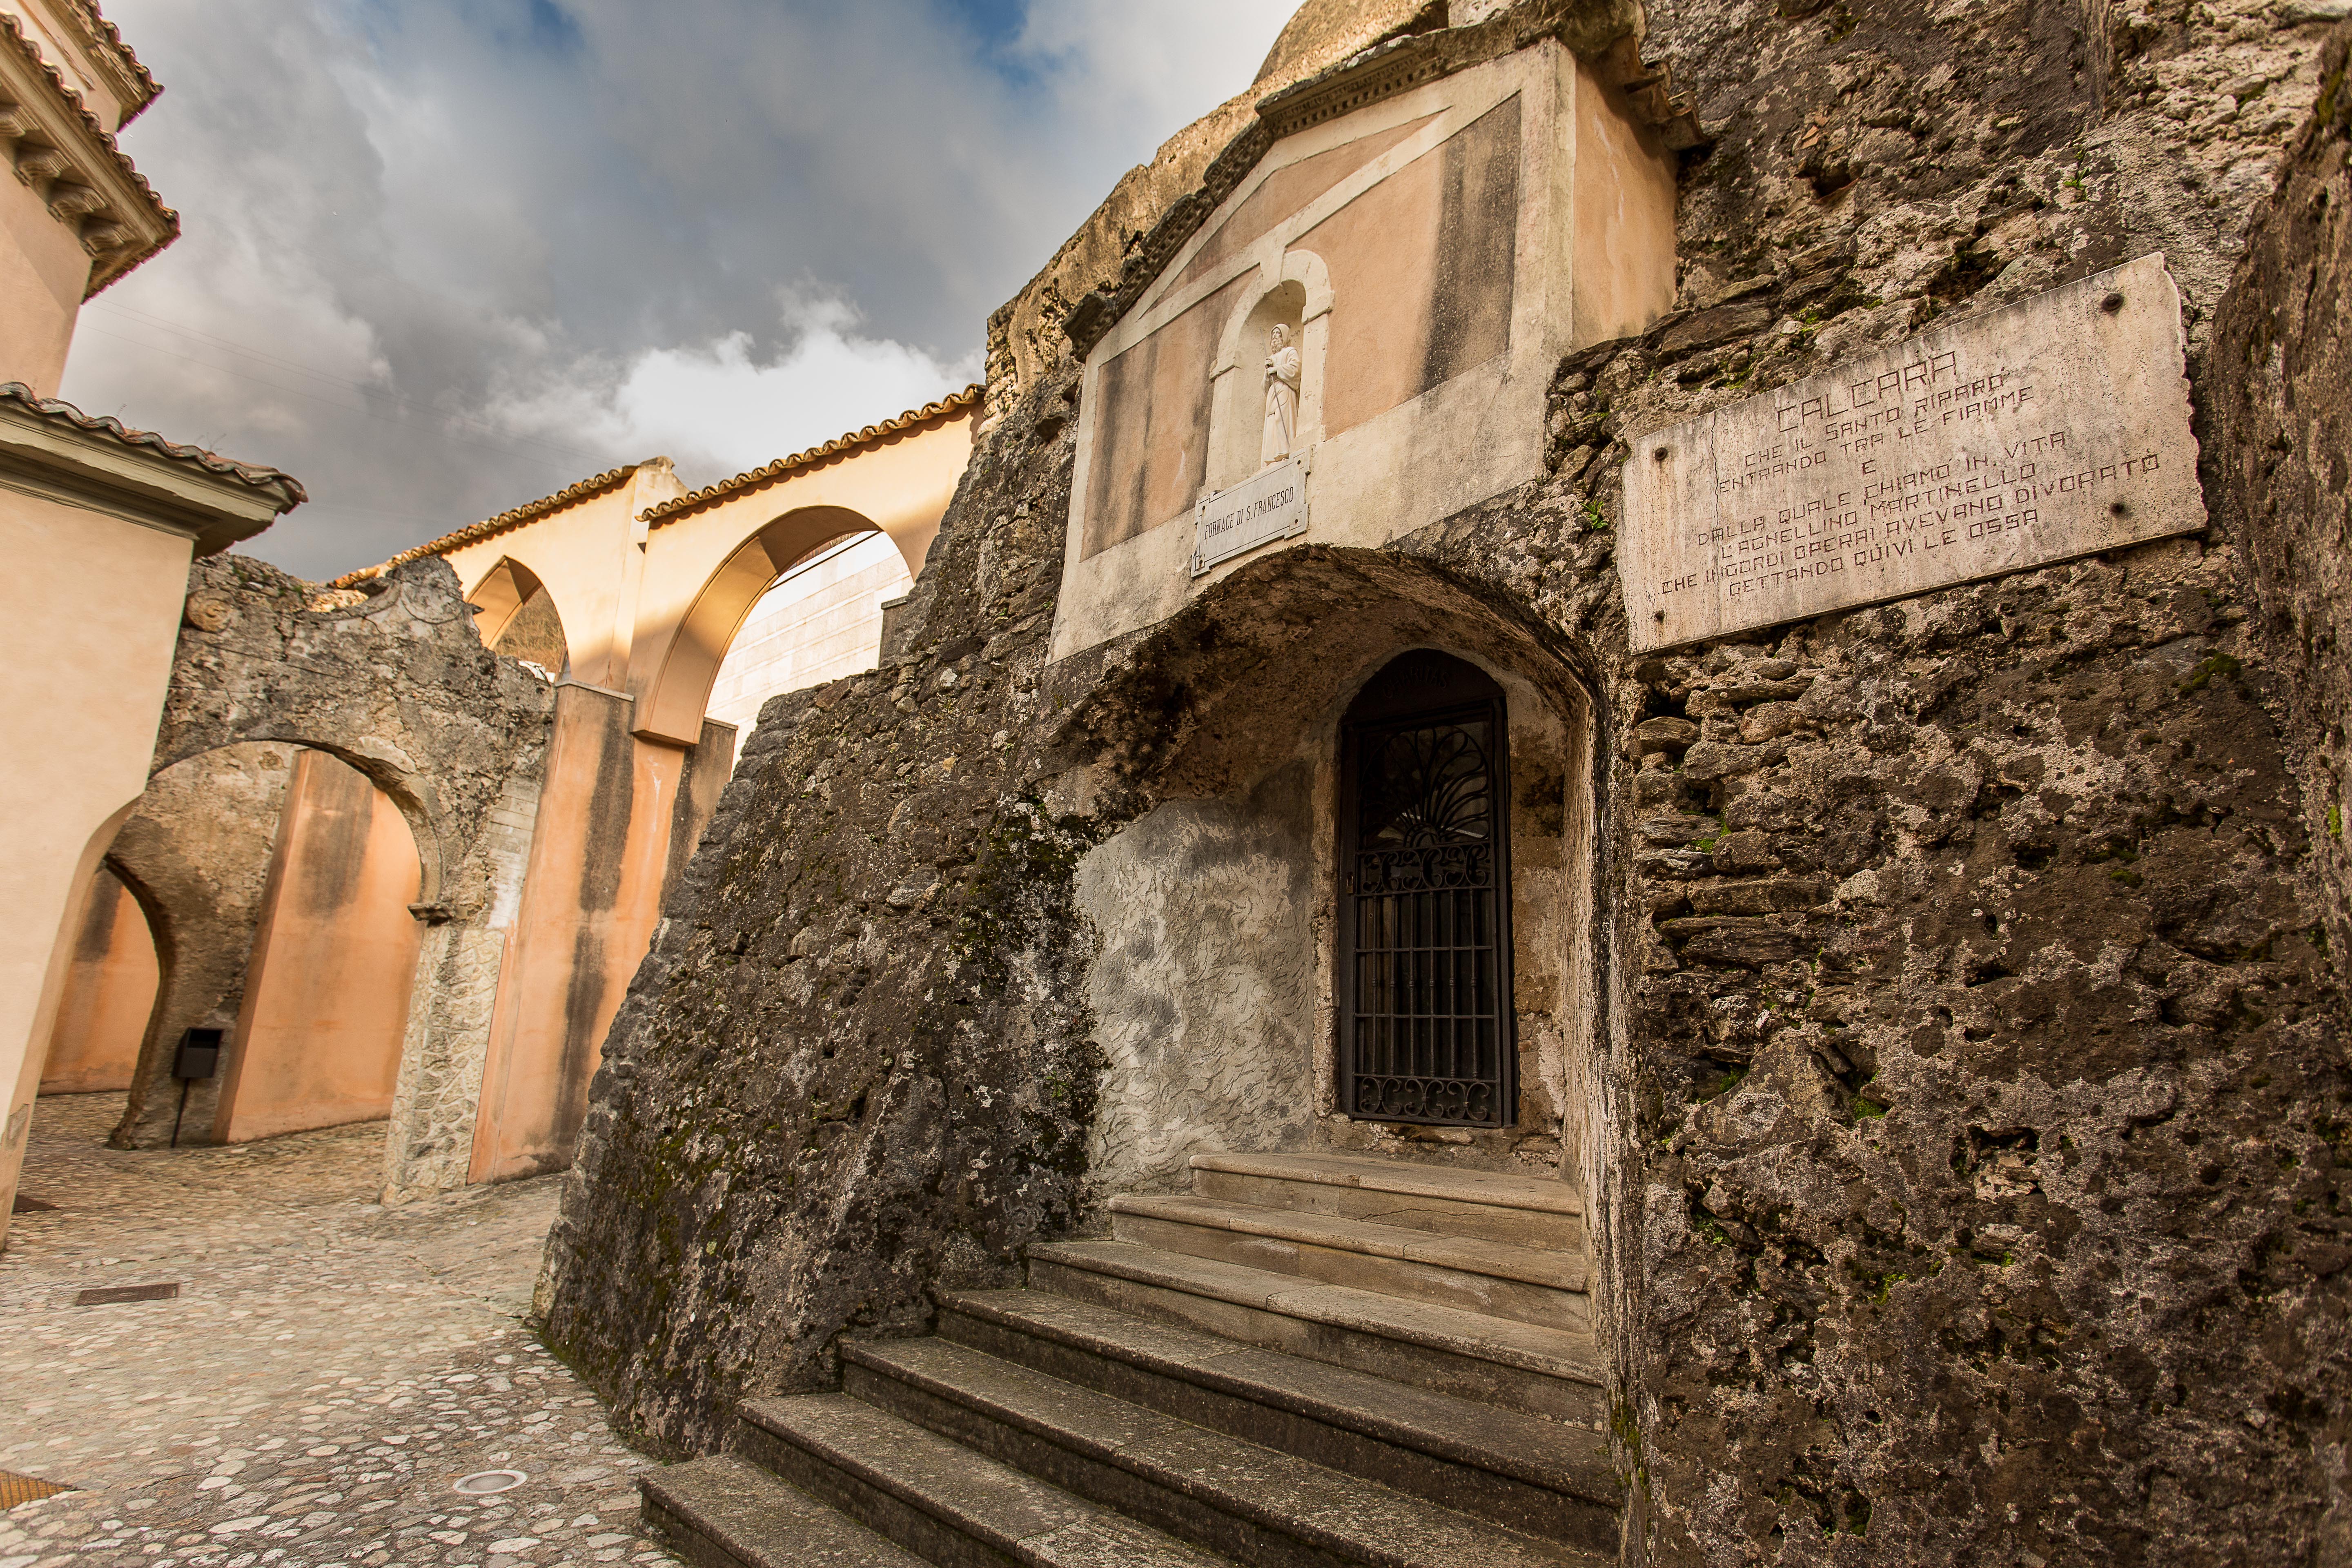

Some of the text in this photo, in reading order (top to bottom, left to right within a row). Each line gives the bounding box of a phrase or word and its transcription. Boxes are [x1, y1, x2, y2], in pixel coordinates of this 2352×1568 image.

[1777, 350, 1956, 433] CALCARA
[1719, 385, 2034, 492] ENTRANDO TRA LE FIAMME
[1745, 445, 1782, 467] CHE
[1796, 437, 1812, 452] IL
[1825, 407, 1900, 441] SANTO
[1862, 459, 1876, 475] E
[1204, 513, 1234, 540] FORNACE
[1236, 508, 1243, 526] DI
[1253, 486, 1294, 518] FRANCESCO
[1662, 453, 2159, 594] CHE INGORDI OPERAI AVEVANO DIVORATO
[1698, 516, 1765, 546] DALLA
[1779, 492, 1851, 524] QUALE
[2005, 431, 2066, 459] VITA
[1721, 463, 2036, 560] L'AGNELLINO MARTINELLO
[1730, 508, 2038, 597] GETTANDO QUIVI LE OSSA
[1382, 666, 1450, 698] CHARITAS
